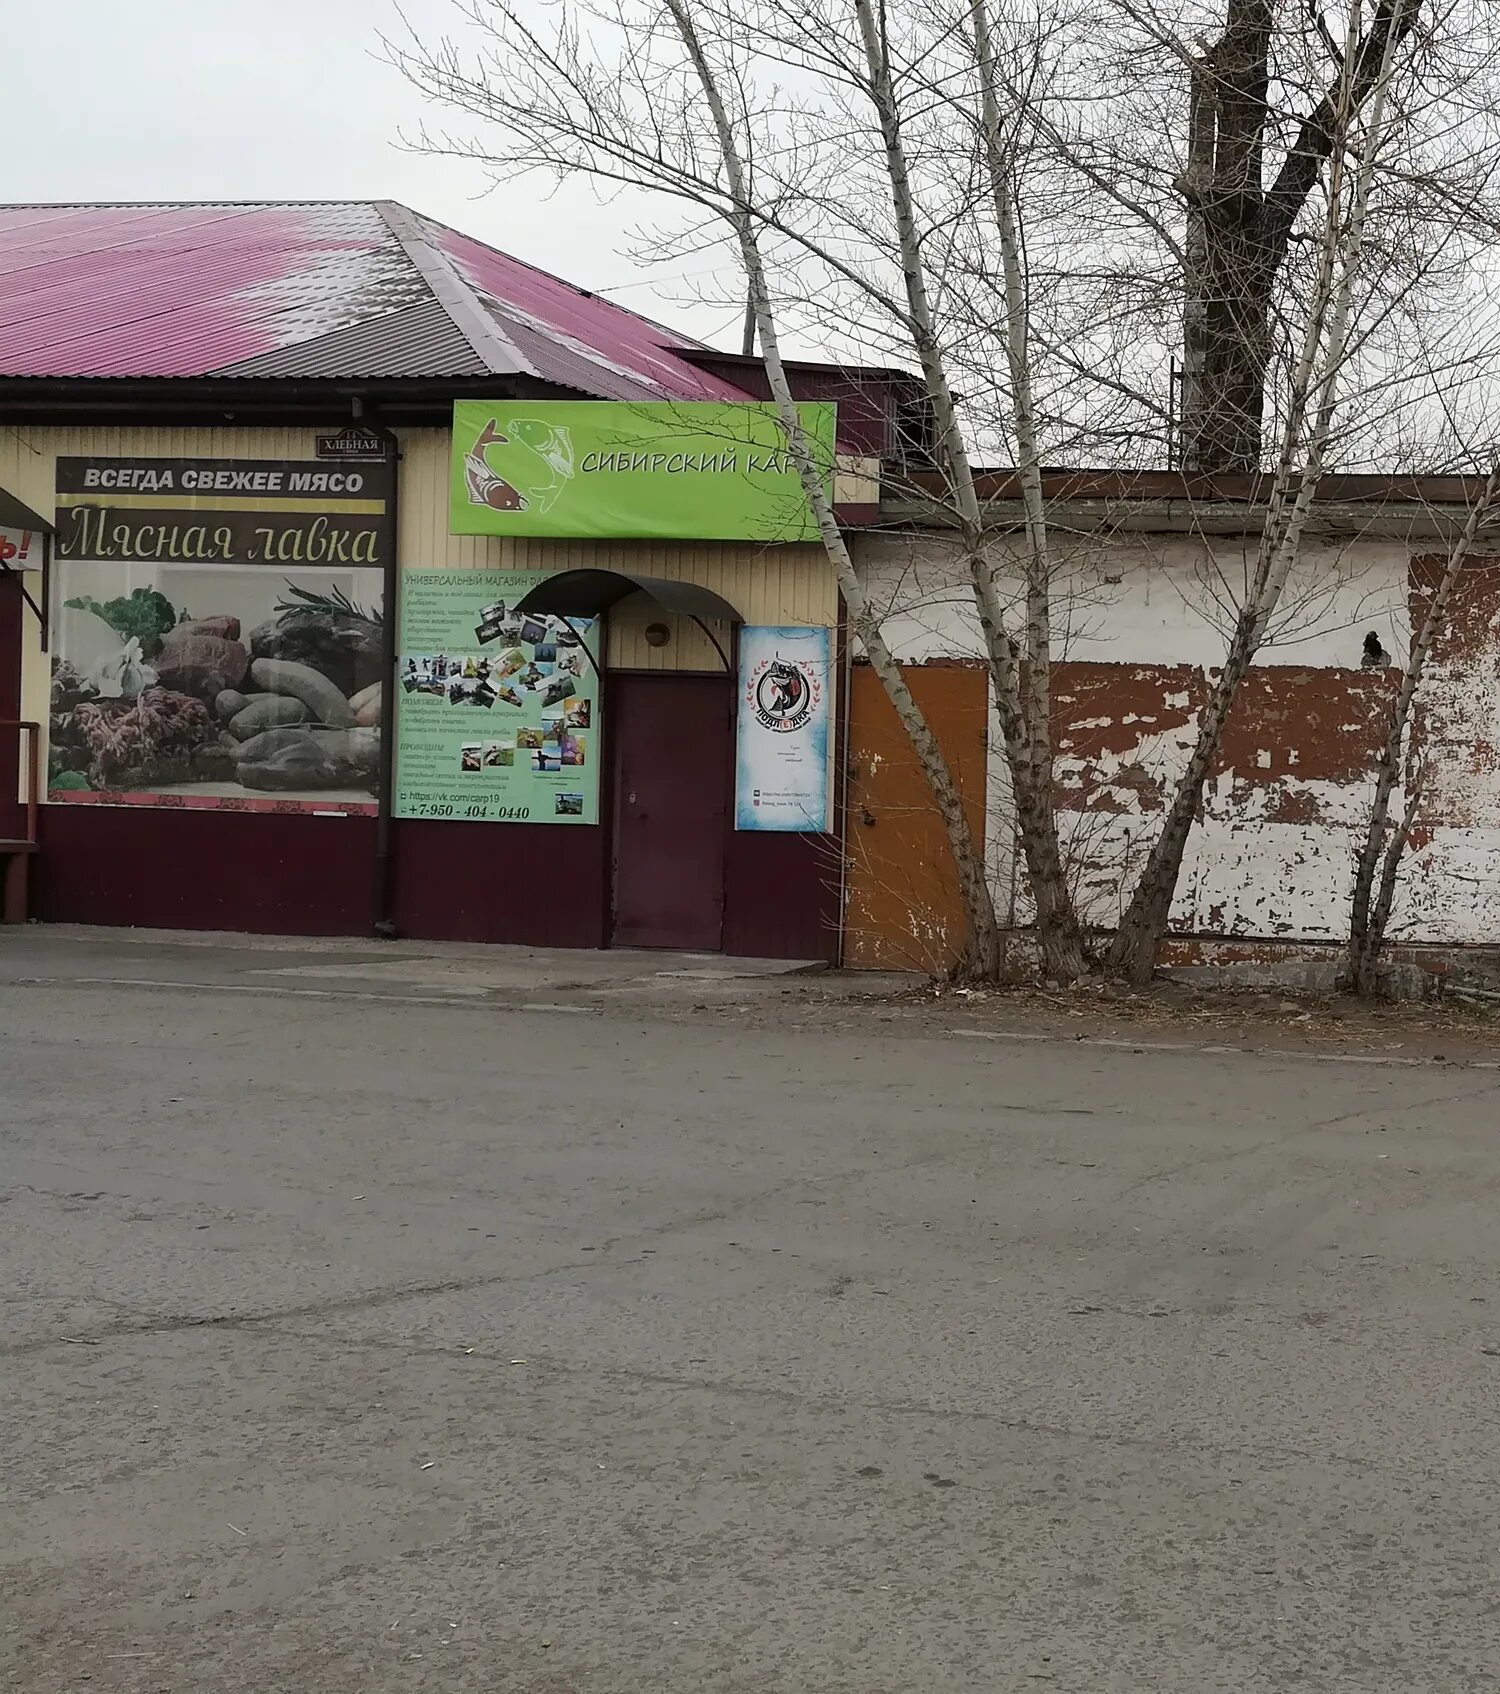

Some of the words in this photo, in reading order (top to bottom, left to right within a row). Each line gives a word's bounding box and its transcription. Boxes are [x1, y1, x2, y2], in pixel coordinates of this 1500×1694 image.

[324, 440, 379, 449] ХЛЕБНАЯ
[580, 448, 737, 473] СИБИРСКИЙ
[746, 454, 797, 474] КАР
[84, 469, 174, 490] ВСЕГДА
[181, 471, 285, 492] СВЕЖЕЕ
[288, 473, 363, 493] МЯСО
[60, 506, 235, 558] Мясная
[247, 516, 380, 563] лавка
[405, 574, 482, 586] УНИВЕРСАЛЬНЫЙ
[485, 575, 528, 586] МАГАЗИН
[409, 791, 500, 804] https://vk.com/carp19
[499, 807, 530, 818] 0440
